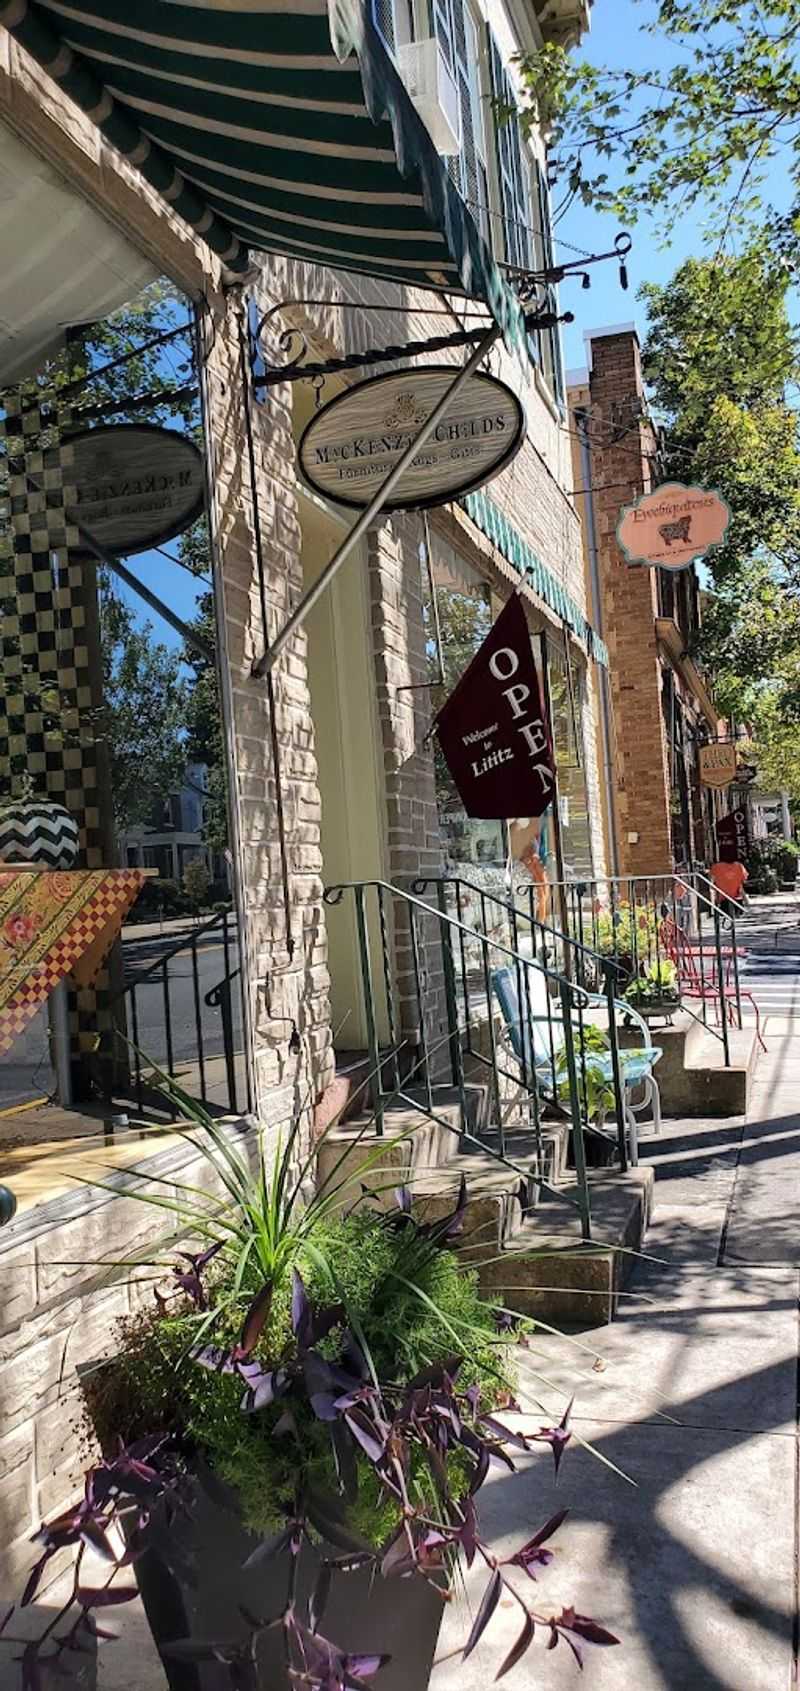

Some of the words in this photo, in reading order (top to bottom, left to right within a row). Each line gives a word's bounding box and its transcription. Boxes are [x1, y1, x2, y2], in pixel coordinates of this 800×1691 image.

[434, 415, 506, 442] CHILDS
[462, 722, 499, 747] Welcome
[488, 647, 555, 795] OPEN
[483, 741, 493, 751] to
[471, 747, 515, 778] Lititz
[733, 811, 748, 859] OPEN
